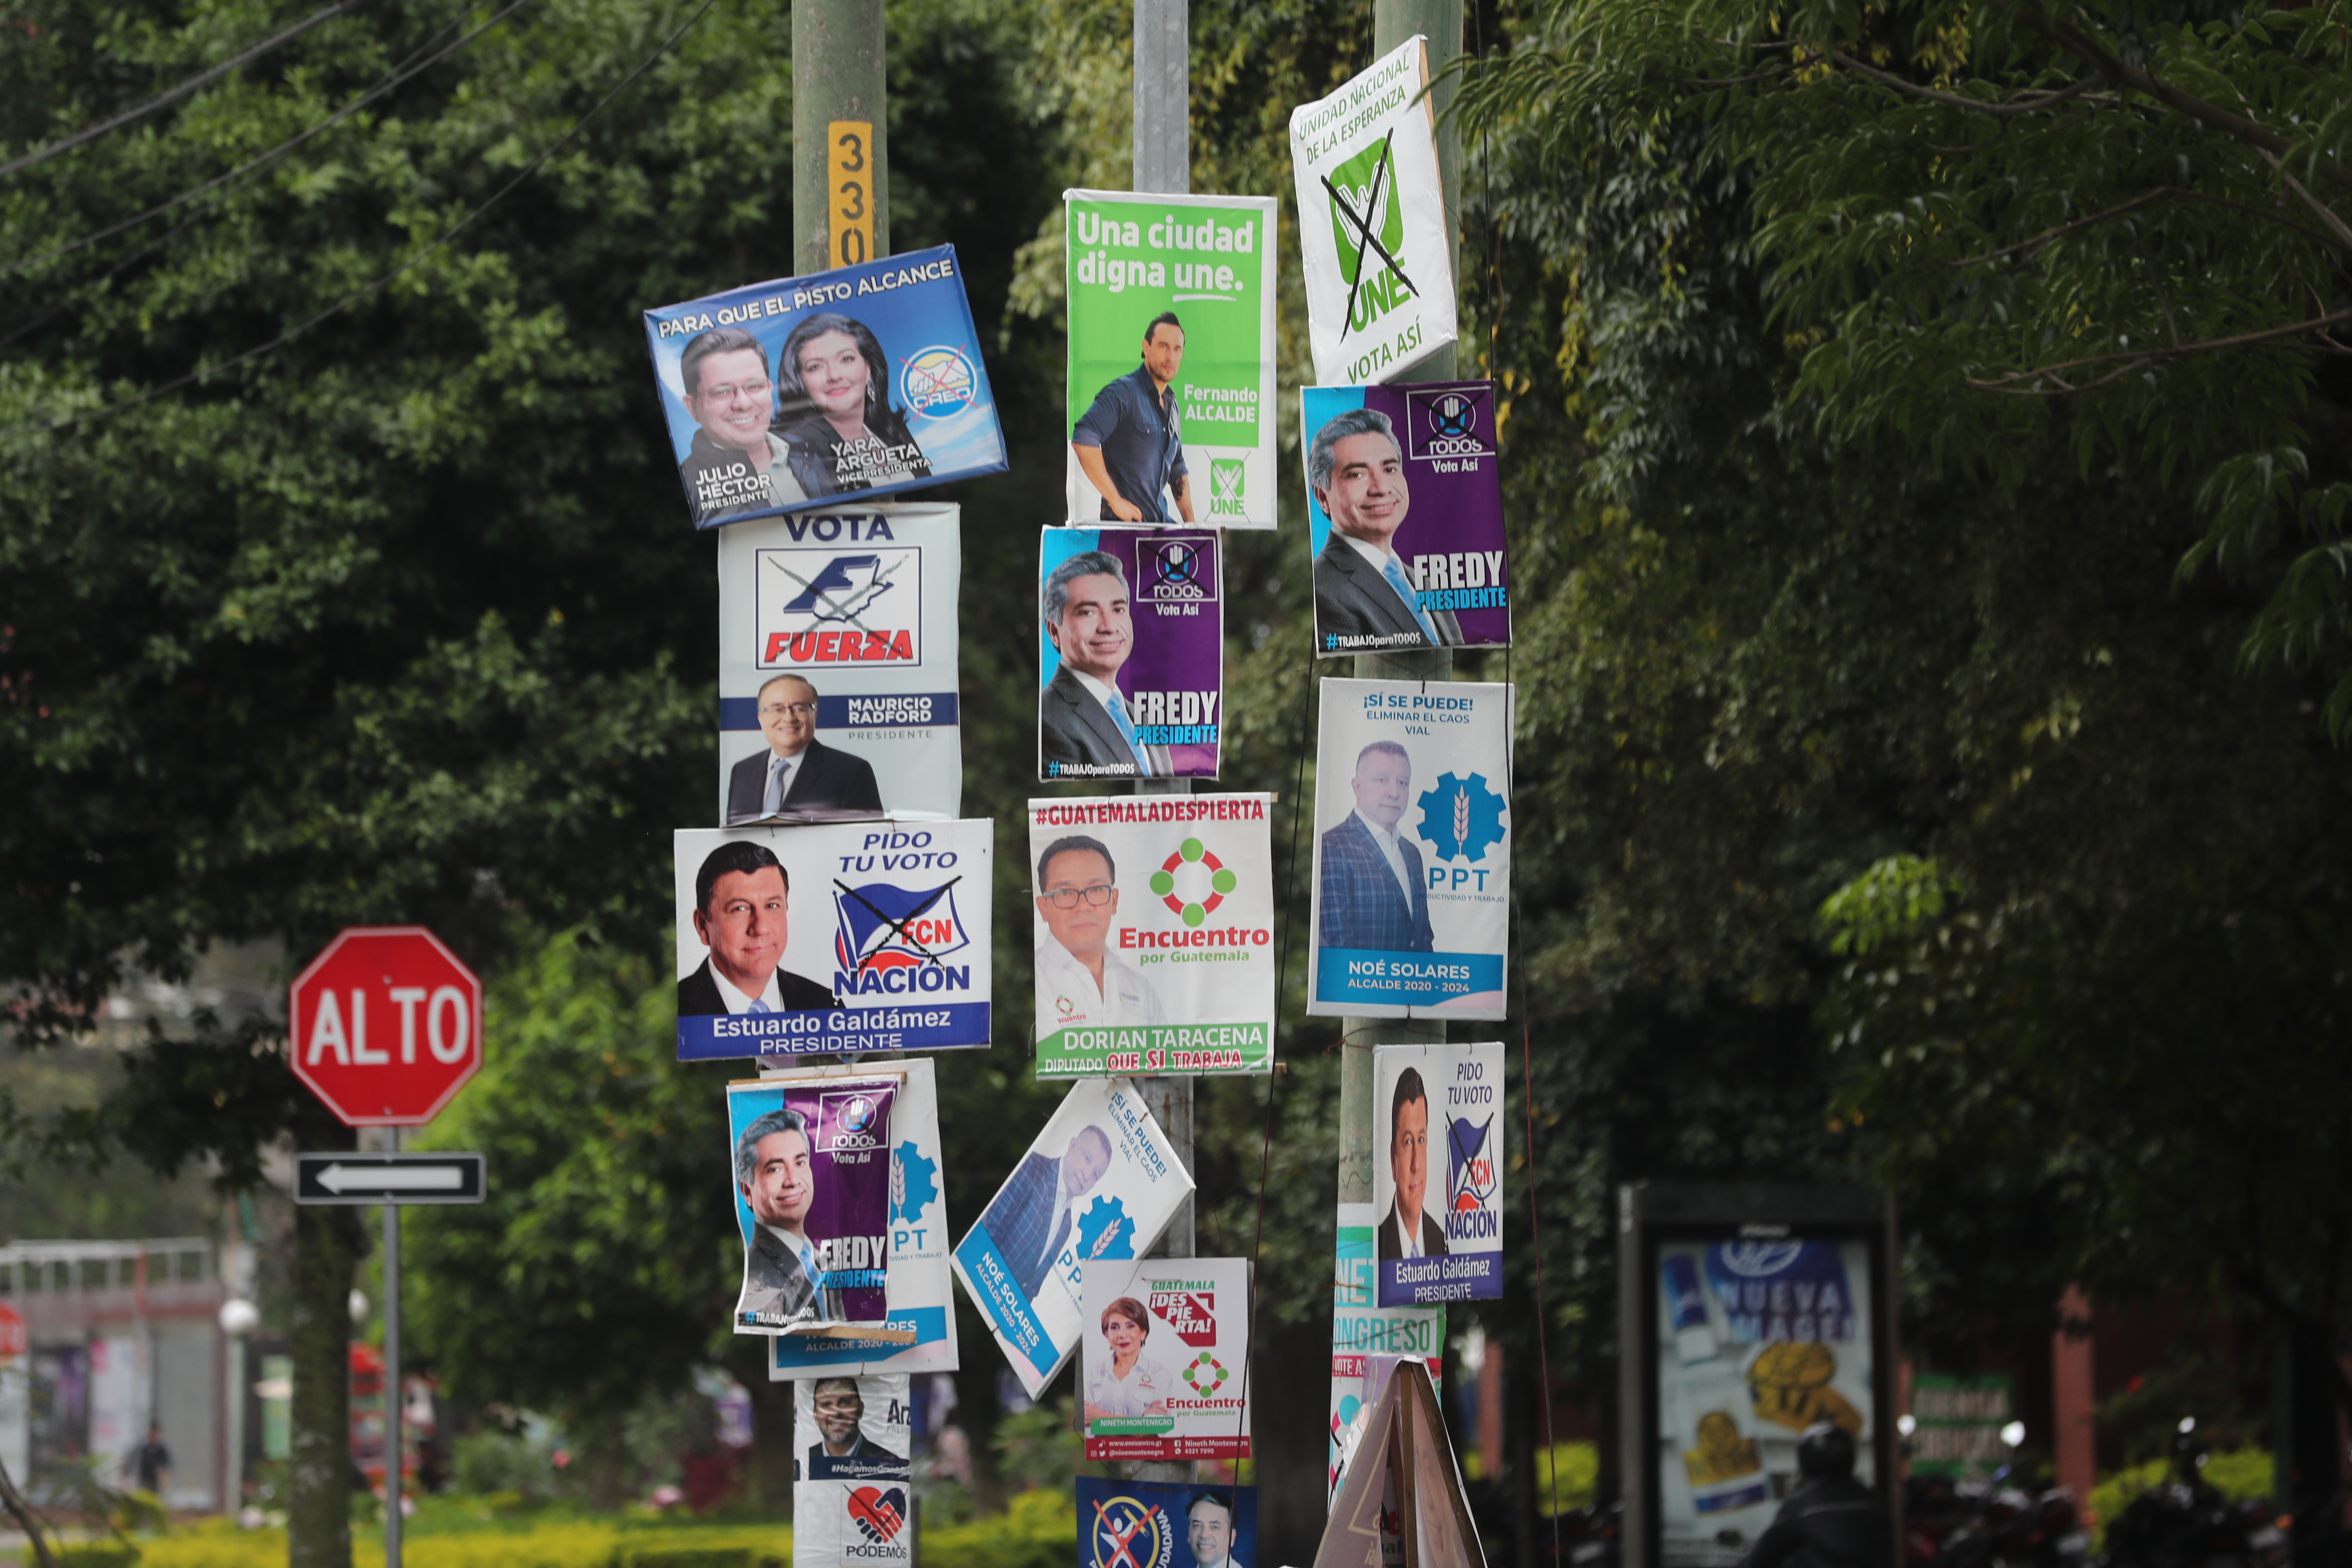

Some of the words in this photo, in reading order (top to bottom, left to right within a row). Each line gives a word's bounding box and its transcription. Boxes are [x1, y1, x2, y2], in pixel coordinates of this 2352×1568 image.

[1299, 98, 1347, 141] UNIDAD
[1350, 54, 1409, 107] NACIONAL
[1306, 146, 1320, 165] DE
[1323, 134, 1336, 153] LA
[1340, 85, 1406, 139] ESPERANZA
[838, 134, 865, 266] 330
[1077, 212, 1139, 247] Una
[1148, 214, 1253, 254] ciudad
[1077, 250, 1165, 293] digna
[1174, 263, 1243, 291] une.
[658, 312, 714, 338] PARA
[717, 302, 762, 327] QUE
[765, 297, 790, 315] EL
[793, 282, 852, 311] PISTO
[857, 260, 954, 297] ALCANCE
[1348, 256, 1411, 333] UNE
[1348, 342, 1393, 385] VOTA
[1396, 315, 1422, 357] ASÍ
[913, 387, 971, 410] CREO
[1184, 384, 1258, 404] Fernando
[1185, 404, 1256, 423] ALCALDE
[830, 435, 881, 457] YARA
[1429, 439, 1482, 455] TODOS
[836, 443, 920, 472] ARGUETA
[1432, 459, 1458, 473] Vota
[1461, 458, 1478, 472] Así
[696, 462, 746, 485] JULIO
[837, 457, 932, 484] VICEPRESIDENTA
[698, 473, 772, 501] HÉCTOR
[701, 490, 769, 511] PRESIDENTE
[1210, 499, 1244, 515] UNE
[784, 514, 894, 542] VOTA
[1413, 550, 1504, 591] FREDY
[1153, 585, 1203, 599] TODOS
[1416, 587, 1506, 612] PRESIDENTE
[1156, 603, 1180, 616] Vota
[1183, 603, 1199, 616] Así
[765, 630, 913, 663] FUERZA
[1326, 632, 1421, 650] #TRABAJOparaTODOS
[848, 697, 932, 711] MAURICIO
[1134, 691, 1217, 725] FREDY
[1364, 692, 1384, 709] ¡SÍ
[1389, 695, 1407, 708] SE
[1413, 697, 1473, 710] PUEDE!
[849, 710, 931, 724] RADFORD
[1367, 711, 1420, 722] ELIMINAR
[1424, 713, 1436, 723] EL
[1439, 714, 1469, 724] CAOS
[849, 730, 933, 740] PRESIDENTE
[1134, 725, 1217, 744] PRESIDENTE
[1405, 725, 1430, 735] VIAL
[1049, 761, 1135, 777] #TRABAJOparaTODOS
[1036, 800, 1264, 825] #GUATEMALADESPIERTA
[863, 832, 932, 850] PIDO
[839, 856, 873, 873] TU
[882, 852, 958, 870] VOTO
[1429, 867, 1490, 891] PPT
[902, 920, 952, 945] FCN
[1120, 926, 1269, 949] Encuentro
[1140, 952, 1165, 966] por
[1170, 950, 1250, 963] Guatemala
[1348, 959, 1384, 976] NOÉ
[1391, 962, 1470, 980] SOLARES
[1348, 979, 1401, 991] ALCALDE
[1404, 981, 1432, 992] 2020
[1442, 982, 1470, 992] 2024
[306, 984, 470, 1066] ALTO
[714, 1012, 821, 1037] Estuardo
[829, 1009, 951, 1033] Galdámez
[760, 1034, 902, 1054] PRESIDENTE
[1064, 1030, 1147, 1050] DORIAN
[1152, 1026, 1263, 1048] TARACENA
[1045, 1058, 1102, 1072] DIPUTADO
[1107, 1054, 1139, 1070] QUE
[1146, 1049, 1165, 1070] SI
[1173, 1050, 1242, 1069] TRABAJA
[1458, 1063, 1482, 1081] PIDO
[1449, 1087, 1461, 1105] TU
[1464, 1086, 1492, 1104] VOTO
[832, 1135, 876, 1148] TODOS
[1109, 1103, 1135, 1146] ELIMINAR
[1133, 1145, 1141, 1159] EL
[1141, 1157, 1157, 1182] CAOS
[1120, 1139, 1133, 1163] VIAL
[1124, 1109, 1137, 1129] SE
[1135, 1126, 1166, 1177] PUEDE!
[833, 1152, 855, 1164] Vota
[858, 1152, 870, 1164] Así
[1471, 1159, 1490, 1186] FCN
[894, 1229, 928, 1252] PT
[819, 1236, 886, 1271] FREDY
[818, 1269, 886, 1289] PRESIDENTE
[1058, 1249, 1082, 1301] PP
[1337, 1258, 1373, 1303] NE
[1396, 1261, 1440, 1284] Estuardo
[1442, 1256, 1490, 1280] Galdámez
[1152, 1281, 1215, 1290] GUATEMALA
[1415, 1283, 1471, 1303] PRESIDENTE
[976, 1263, 1002, 1305] ALCALDE
[1000, 1303, 1015, 1327] 2020
[1016, 1332, 1031, 1355] 2024
[982, 1252, 1004, 1286] NOÉ
[1001, 1283, 1039, 1347] SOLARES
[1152, 1293, 1187, 1309] ¡DES
[1166, 1307, 1192, 1320] PIE
[1175, 1319, 1212, 1333] RTA!
[1335, 1317, 1430, 1352] ONGRESO
[806, 1341, 854, 1352] ALCALDE
[1335, 1359, 1353, 1375] VOTE
[1166, 1398, 1246, 1409] Encuentro
[846, 1546, 906, 1559] PODEMOS
